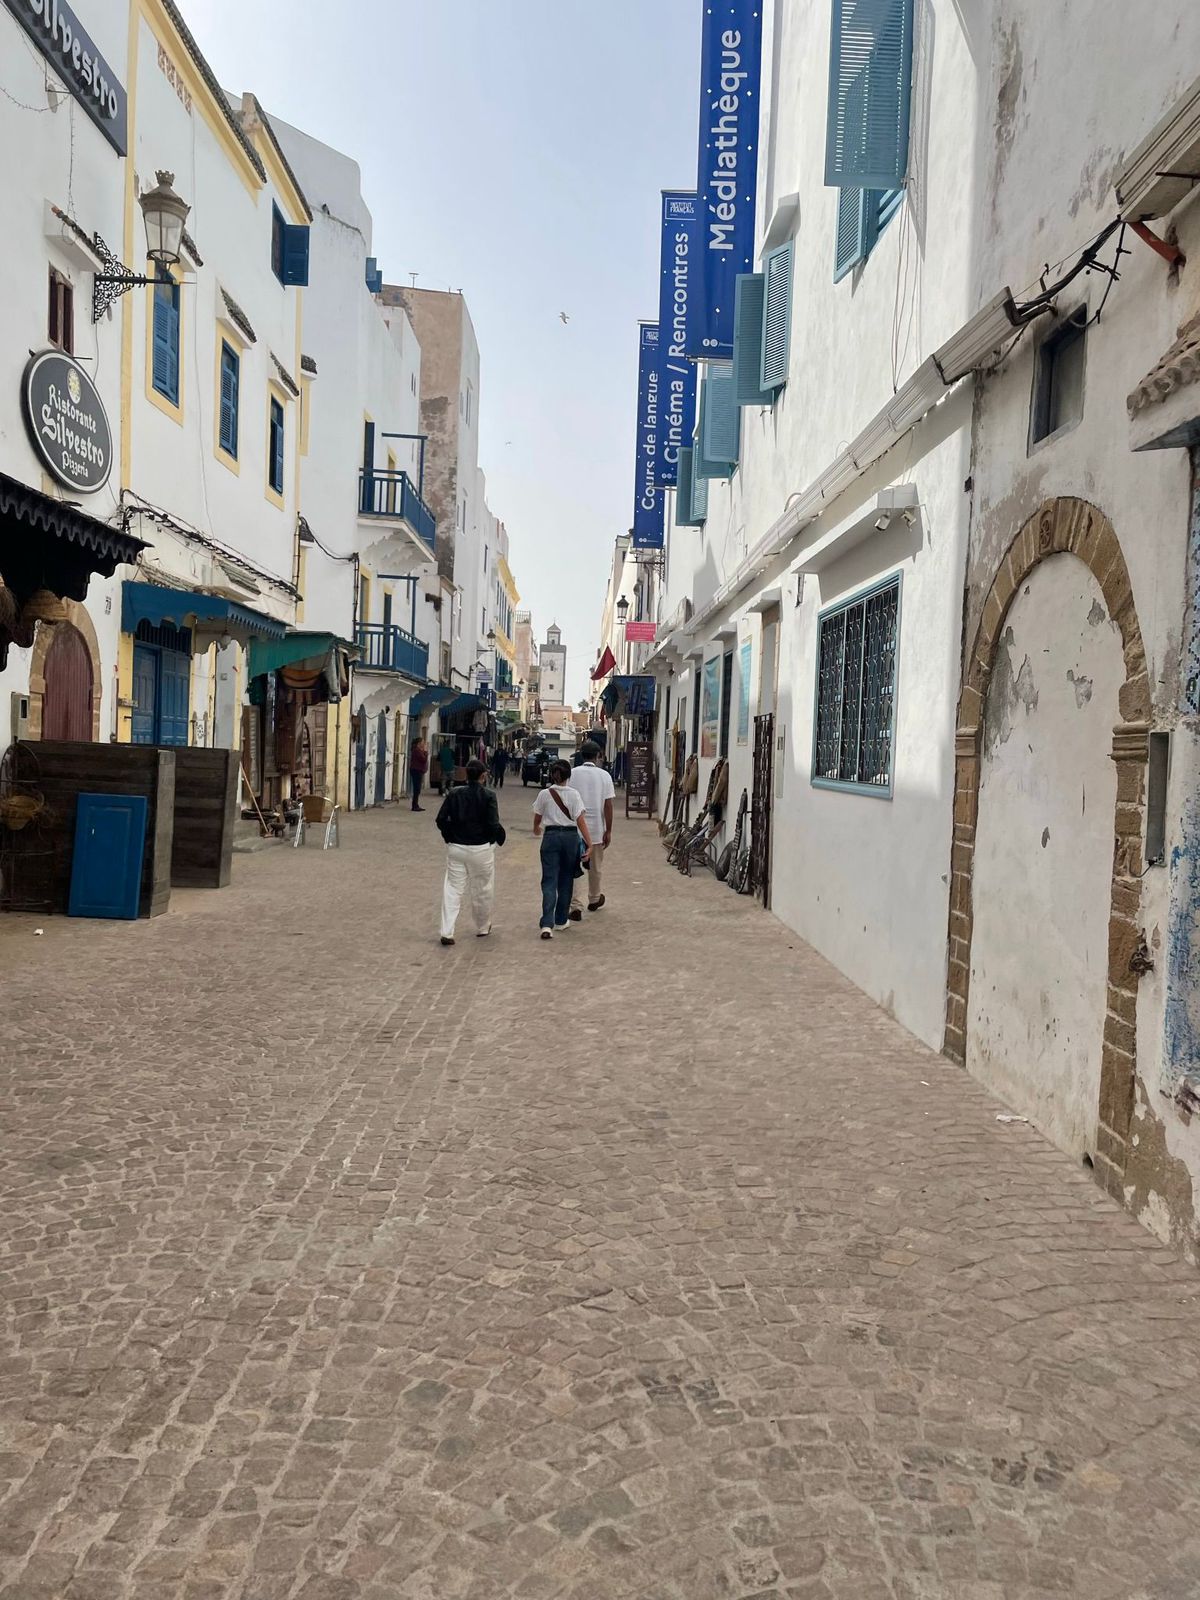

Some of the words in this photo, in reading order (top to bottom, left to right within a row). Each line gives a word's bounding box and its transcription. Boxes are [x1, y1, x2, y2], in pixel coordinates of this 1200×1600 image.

[29, 0, 117, 119] ilvestro
[709, 29, 748, 250] Médiathèque
[668, 232, 689, 358] Rencontres
[48, 384, 97, 434] Ristorante
[644, 372, 659, 429] langue
[663, 380, 684, 464] Cinéma
[41, 403, 104, 468] Silvestro
[61, 450, 89, 478] Pizzeria
[643, 434, 657, 456] de
[641, 461, 655, 510] Cours
